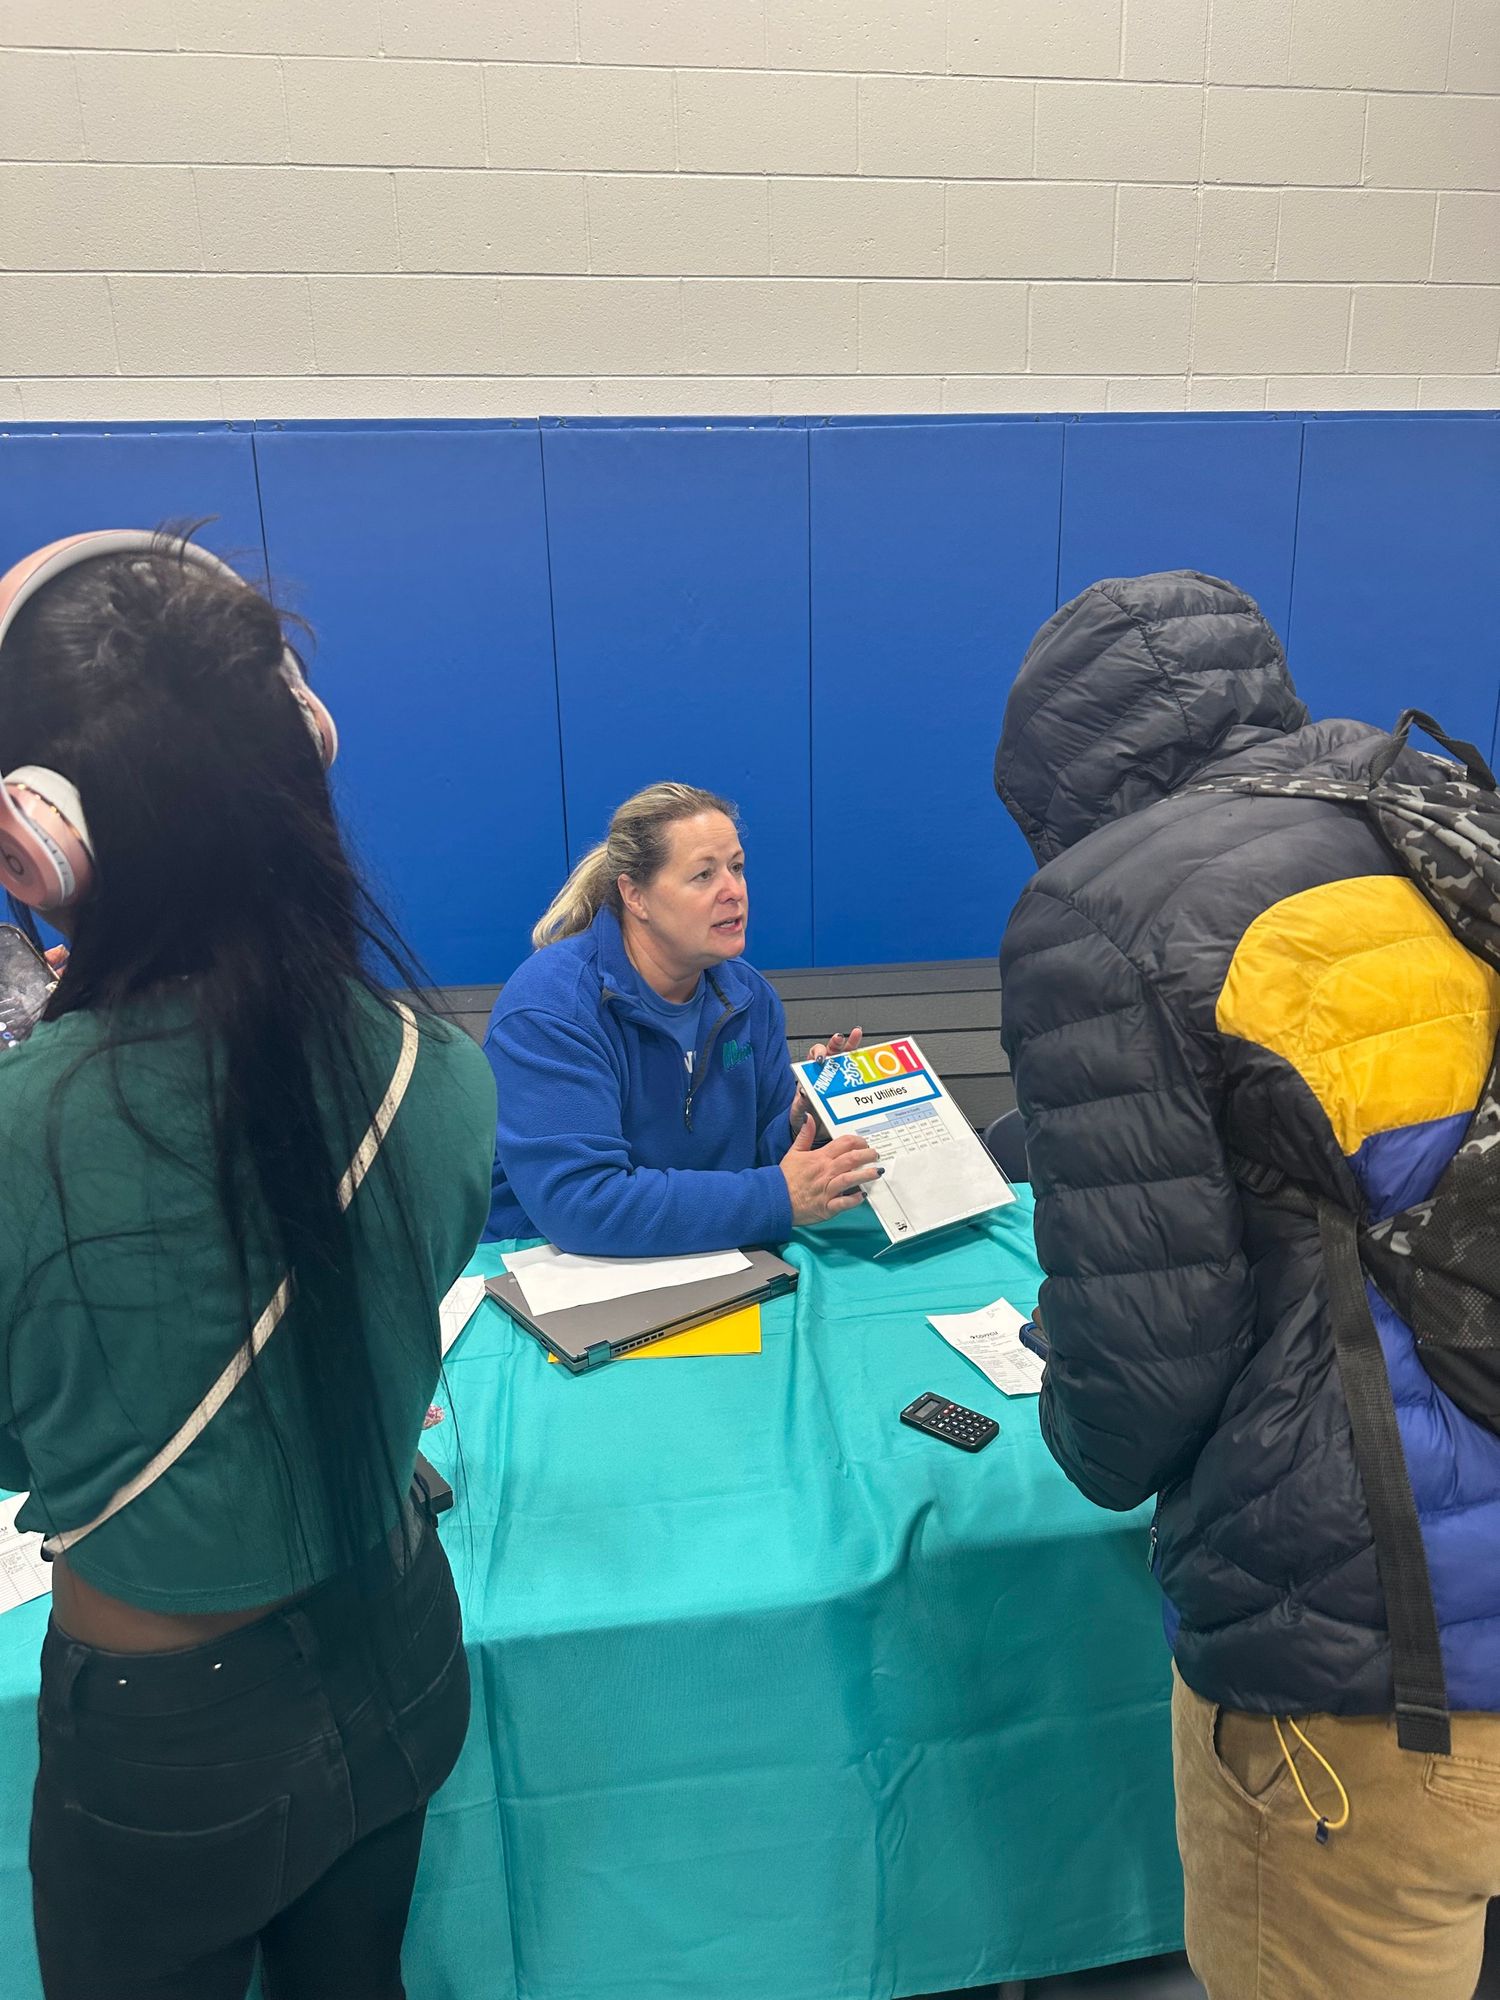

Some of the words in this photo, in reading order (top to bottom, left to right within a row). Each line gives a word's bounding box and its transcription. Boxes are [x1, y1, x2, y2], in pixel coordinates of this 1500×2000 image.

[813, 1058, 841, 1095] FINANCES
[857, 1045, 918, 1079] 101
[854, 1095, 874, 1106] Pay
[874, 1086, 908, 1101] Utilities
